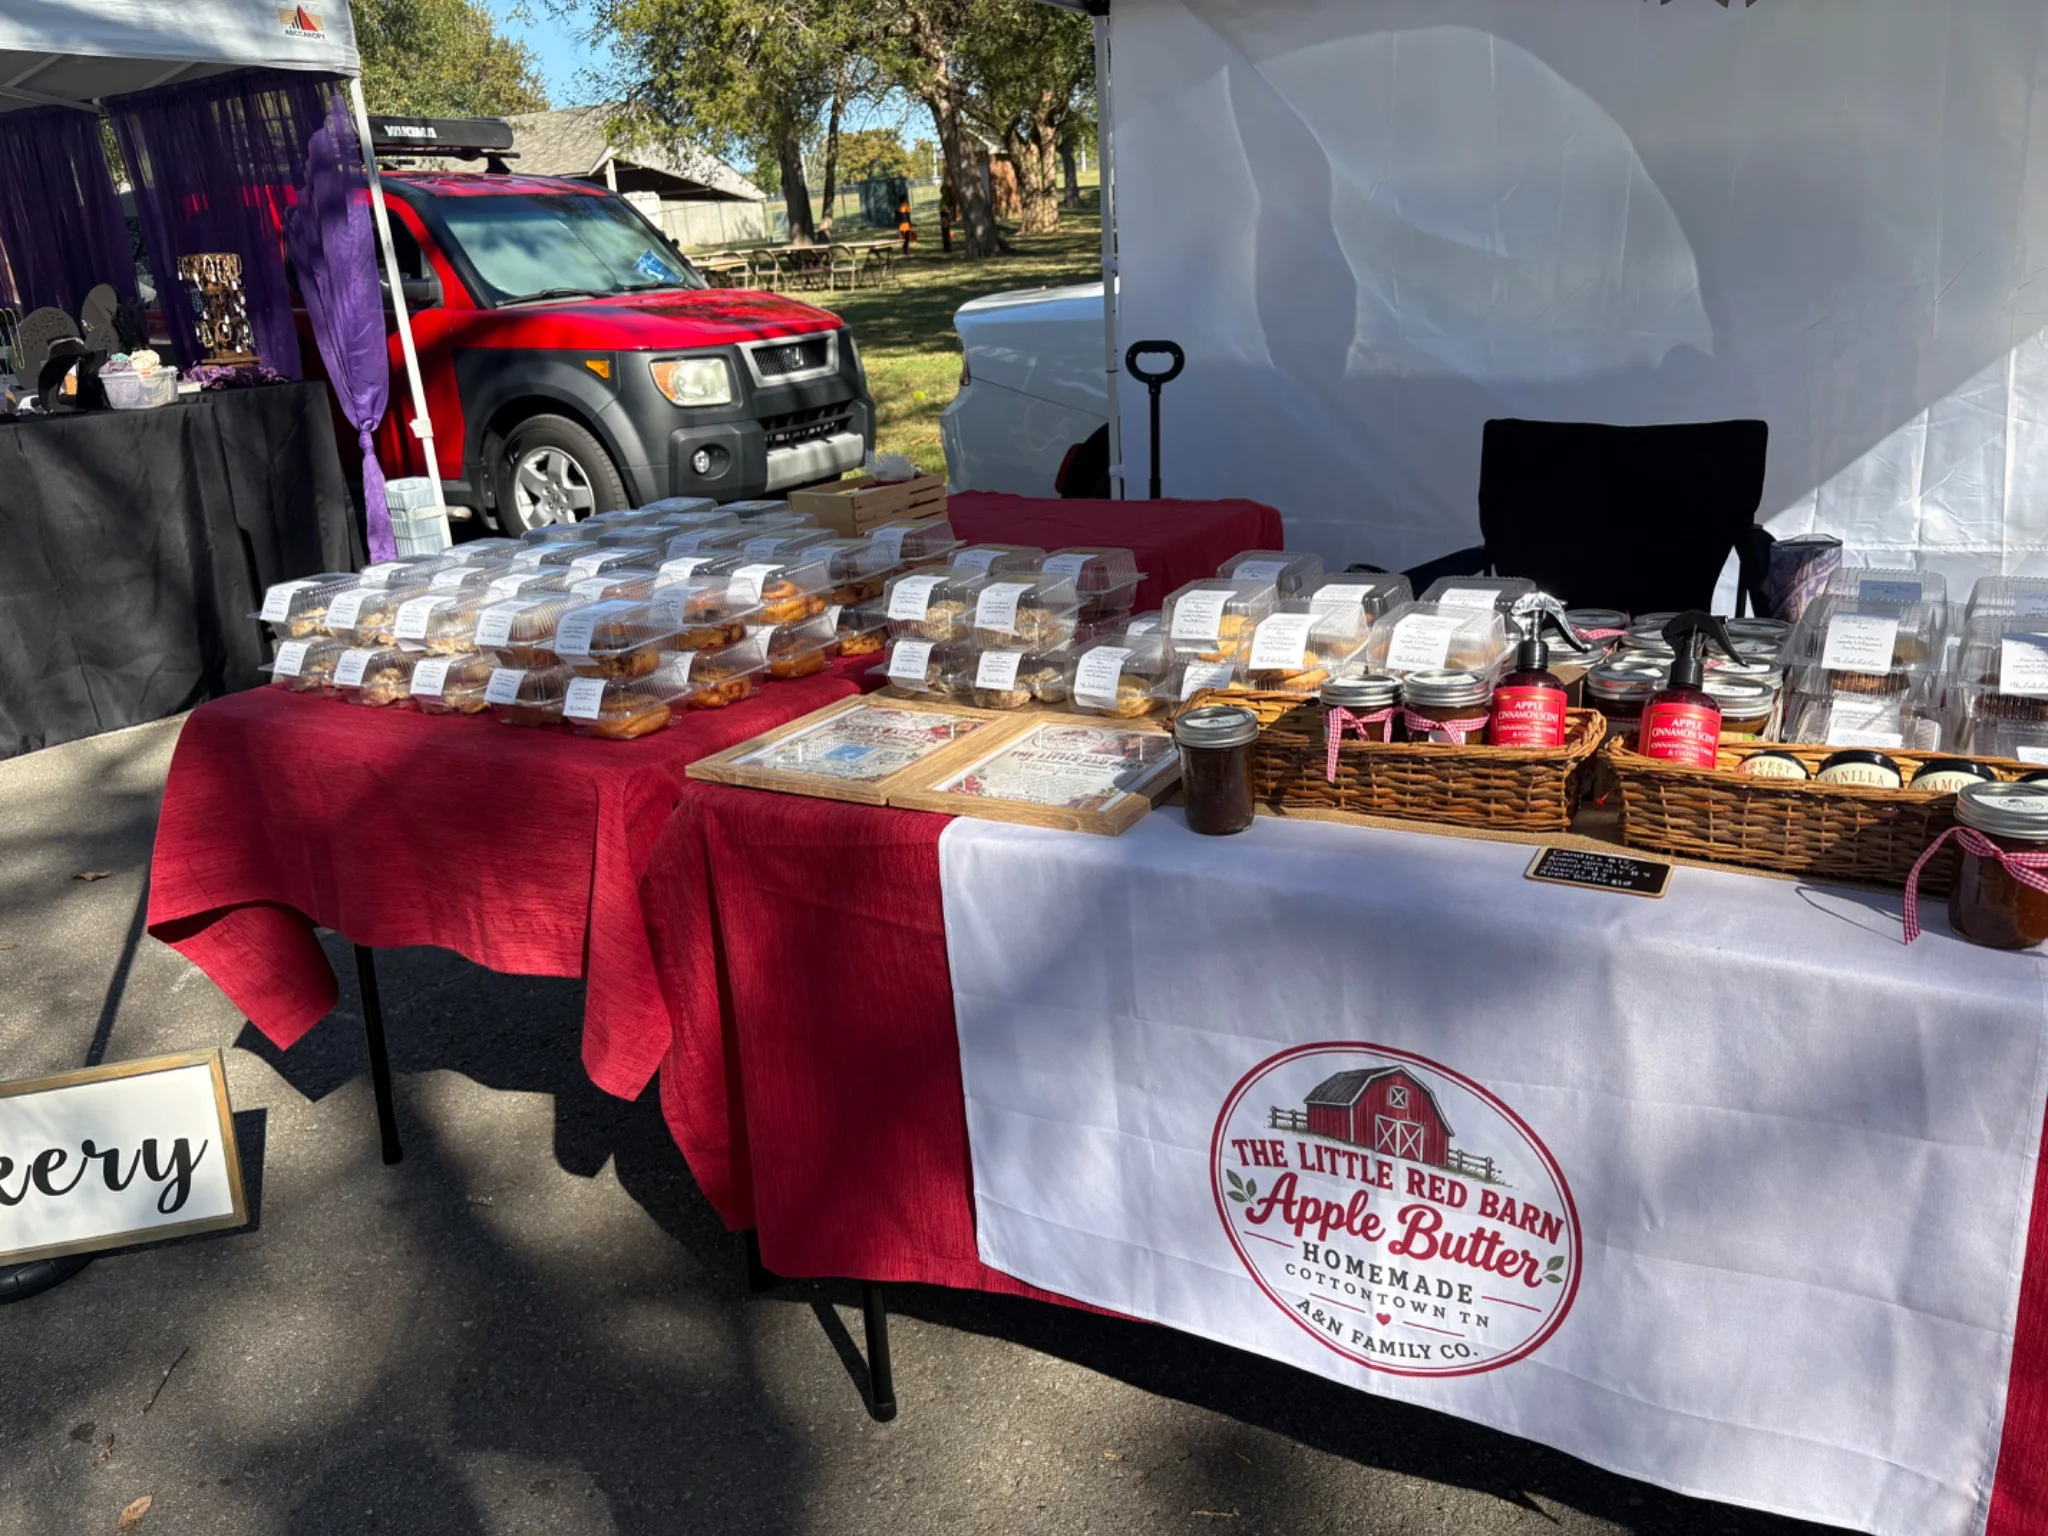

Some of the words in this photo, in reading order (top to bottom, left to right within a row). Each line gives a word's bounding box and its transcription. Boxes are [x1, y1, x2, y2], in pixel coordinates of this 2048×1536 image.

[384, 125, 437, 138] YAKIMA
[1515, 701, 1543, 710] APPLE
[1499, 711, 1538, 720] CINNAMON
[1672, 718, 1703, 730] APPLE
[1652, 727, 1696, 738] CINNAMON
[1825, 770, 1884, 786] VANILLA
[1232, 1138, 1289, 1167] THE
[1297, 1142, 1393, 1190] LITTLE
[1406, 1167, 1468, 1208] RED
[1478, 1188, 1566, 1246] BARN
[1245, 1171, 1387, 1243] Apple
[1387, 1203, 1544, 1289] Butter
[1302, 1241, 1474, 1305] HOMEMADE
[1285, 1263, 1446, 1319] COTTONTOWN
[1459, 1311, 1490, 1328] TN
[1296, 1299, 1342, 1336] A&N
[1351, 1331, 1432, 1360] FAMILY
[1439, 1342, 1479, 1359] CO.
